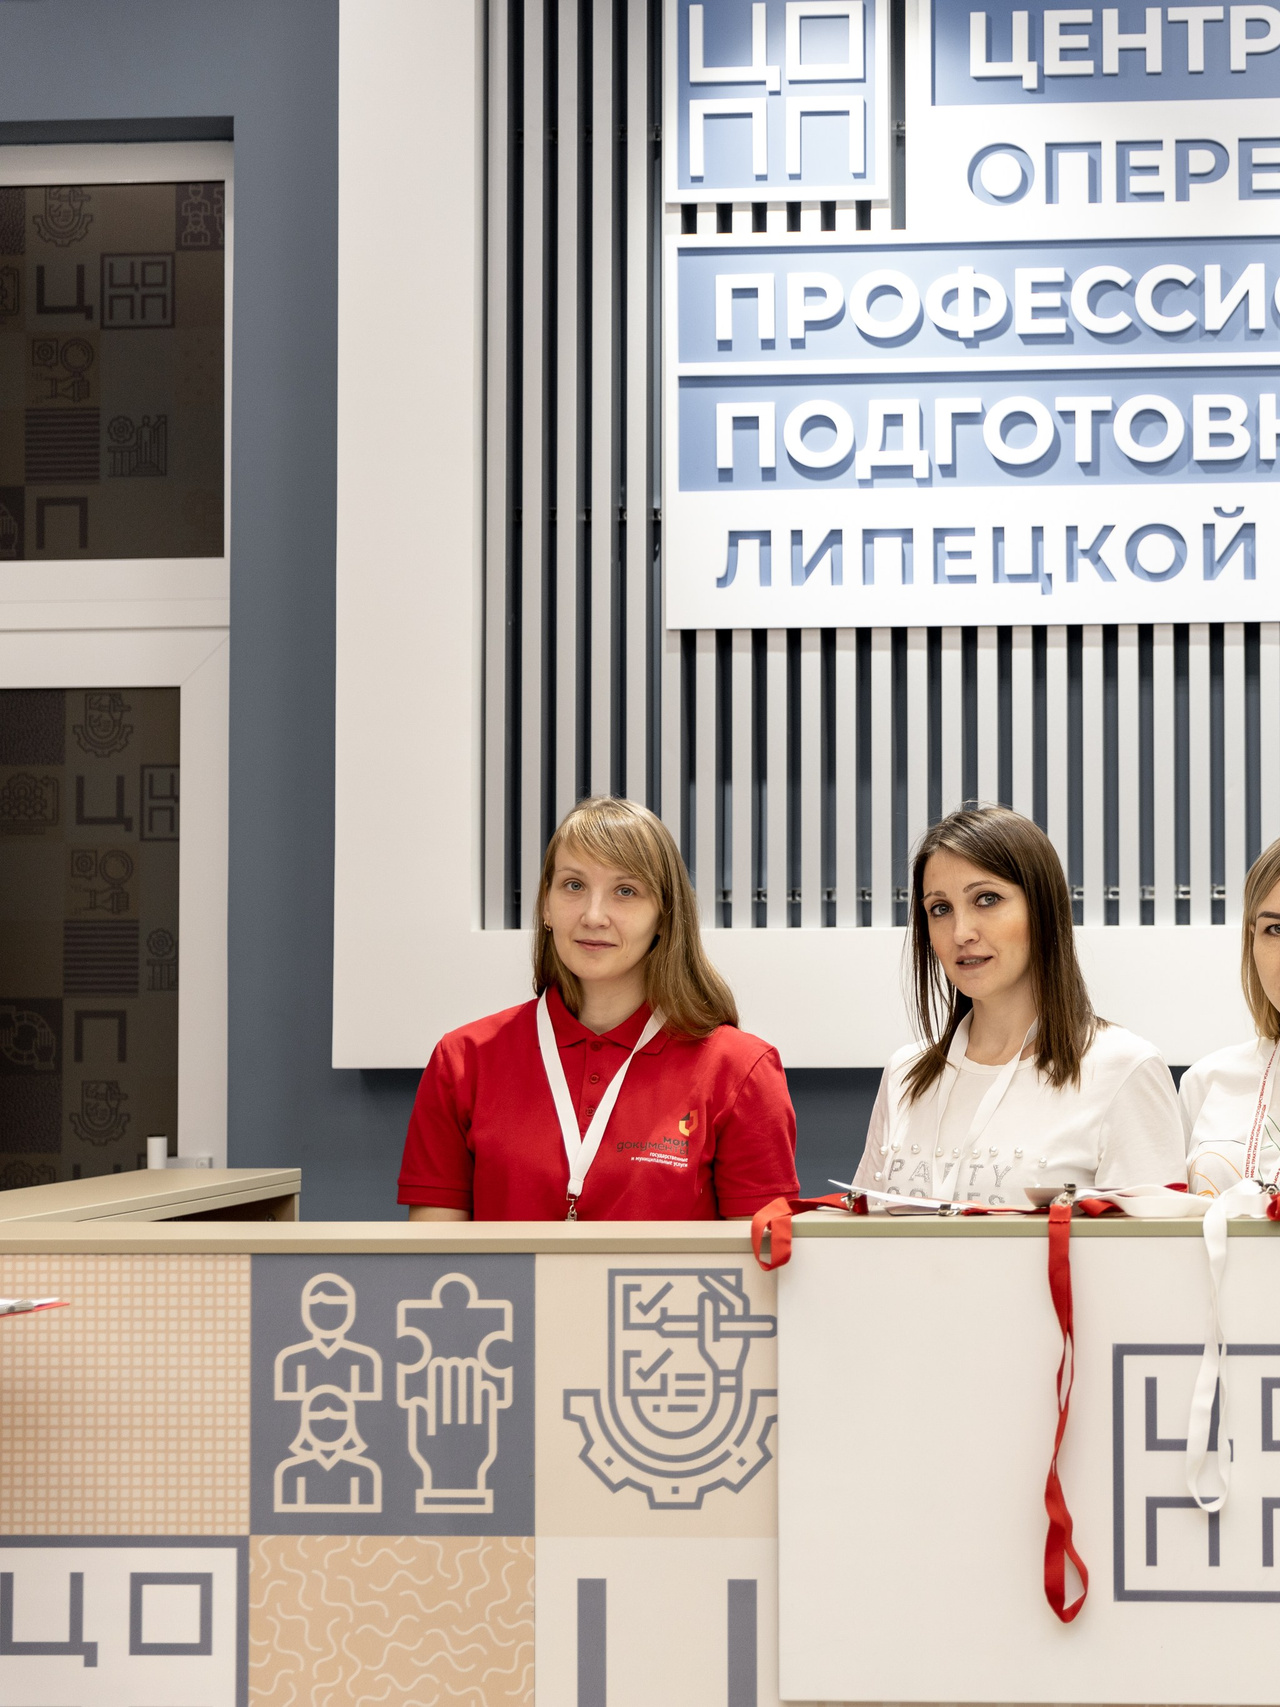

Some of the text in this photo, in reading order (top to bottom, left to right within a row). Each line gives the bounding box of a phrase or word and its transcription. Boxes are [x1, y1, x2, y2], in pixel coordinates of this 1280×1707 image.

[716, 506, 1257, 595] ЛИПЕЦКОЙ
[616, 1141, 689, 1156] документы
[663, 1136, 689, 1147] мои
